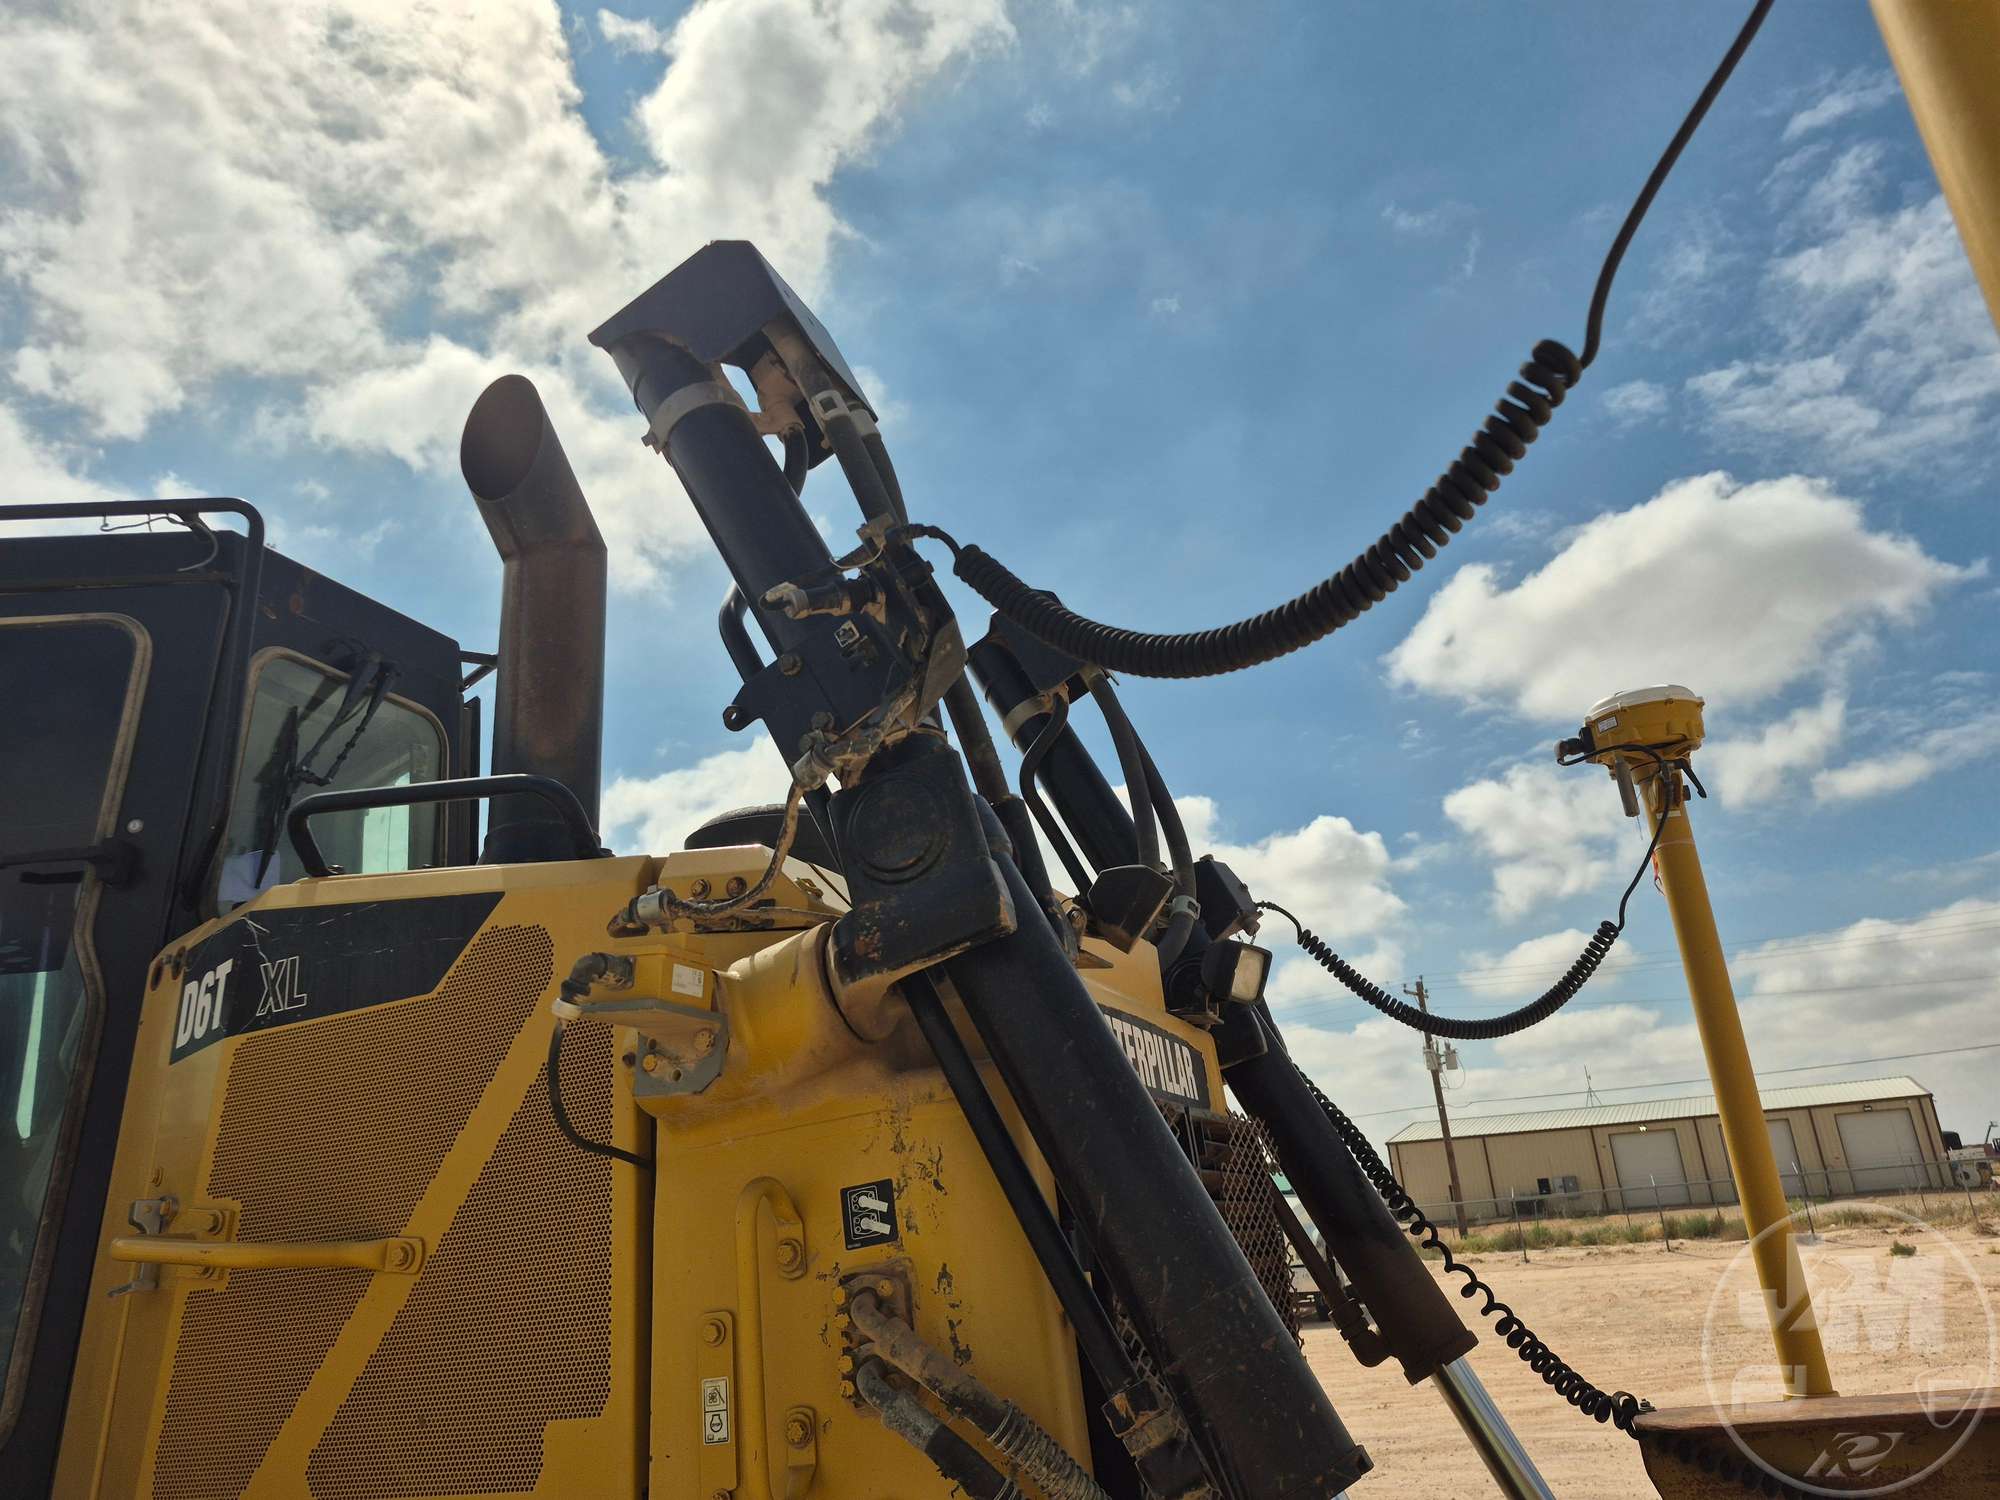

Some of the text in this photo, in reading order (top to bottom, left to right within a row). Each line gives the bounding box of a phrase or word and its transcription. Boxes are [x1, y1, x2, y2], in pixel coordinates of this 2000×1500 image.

[176, 955, 307, 1049] D6T XL
[1103, 1014, 1199, 1100] TERPILLAR
